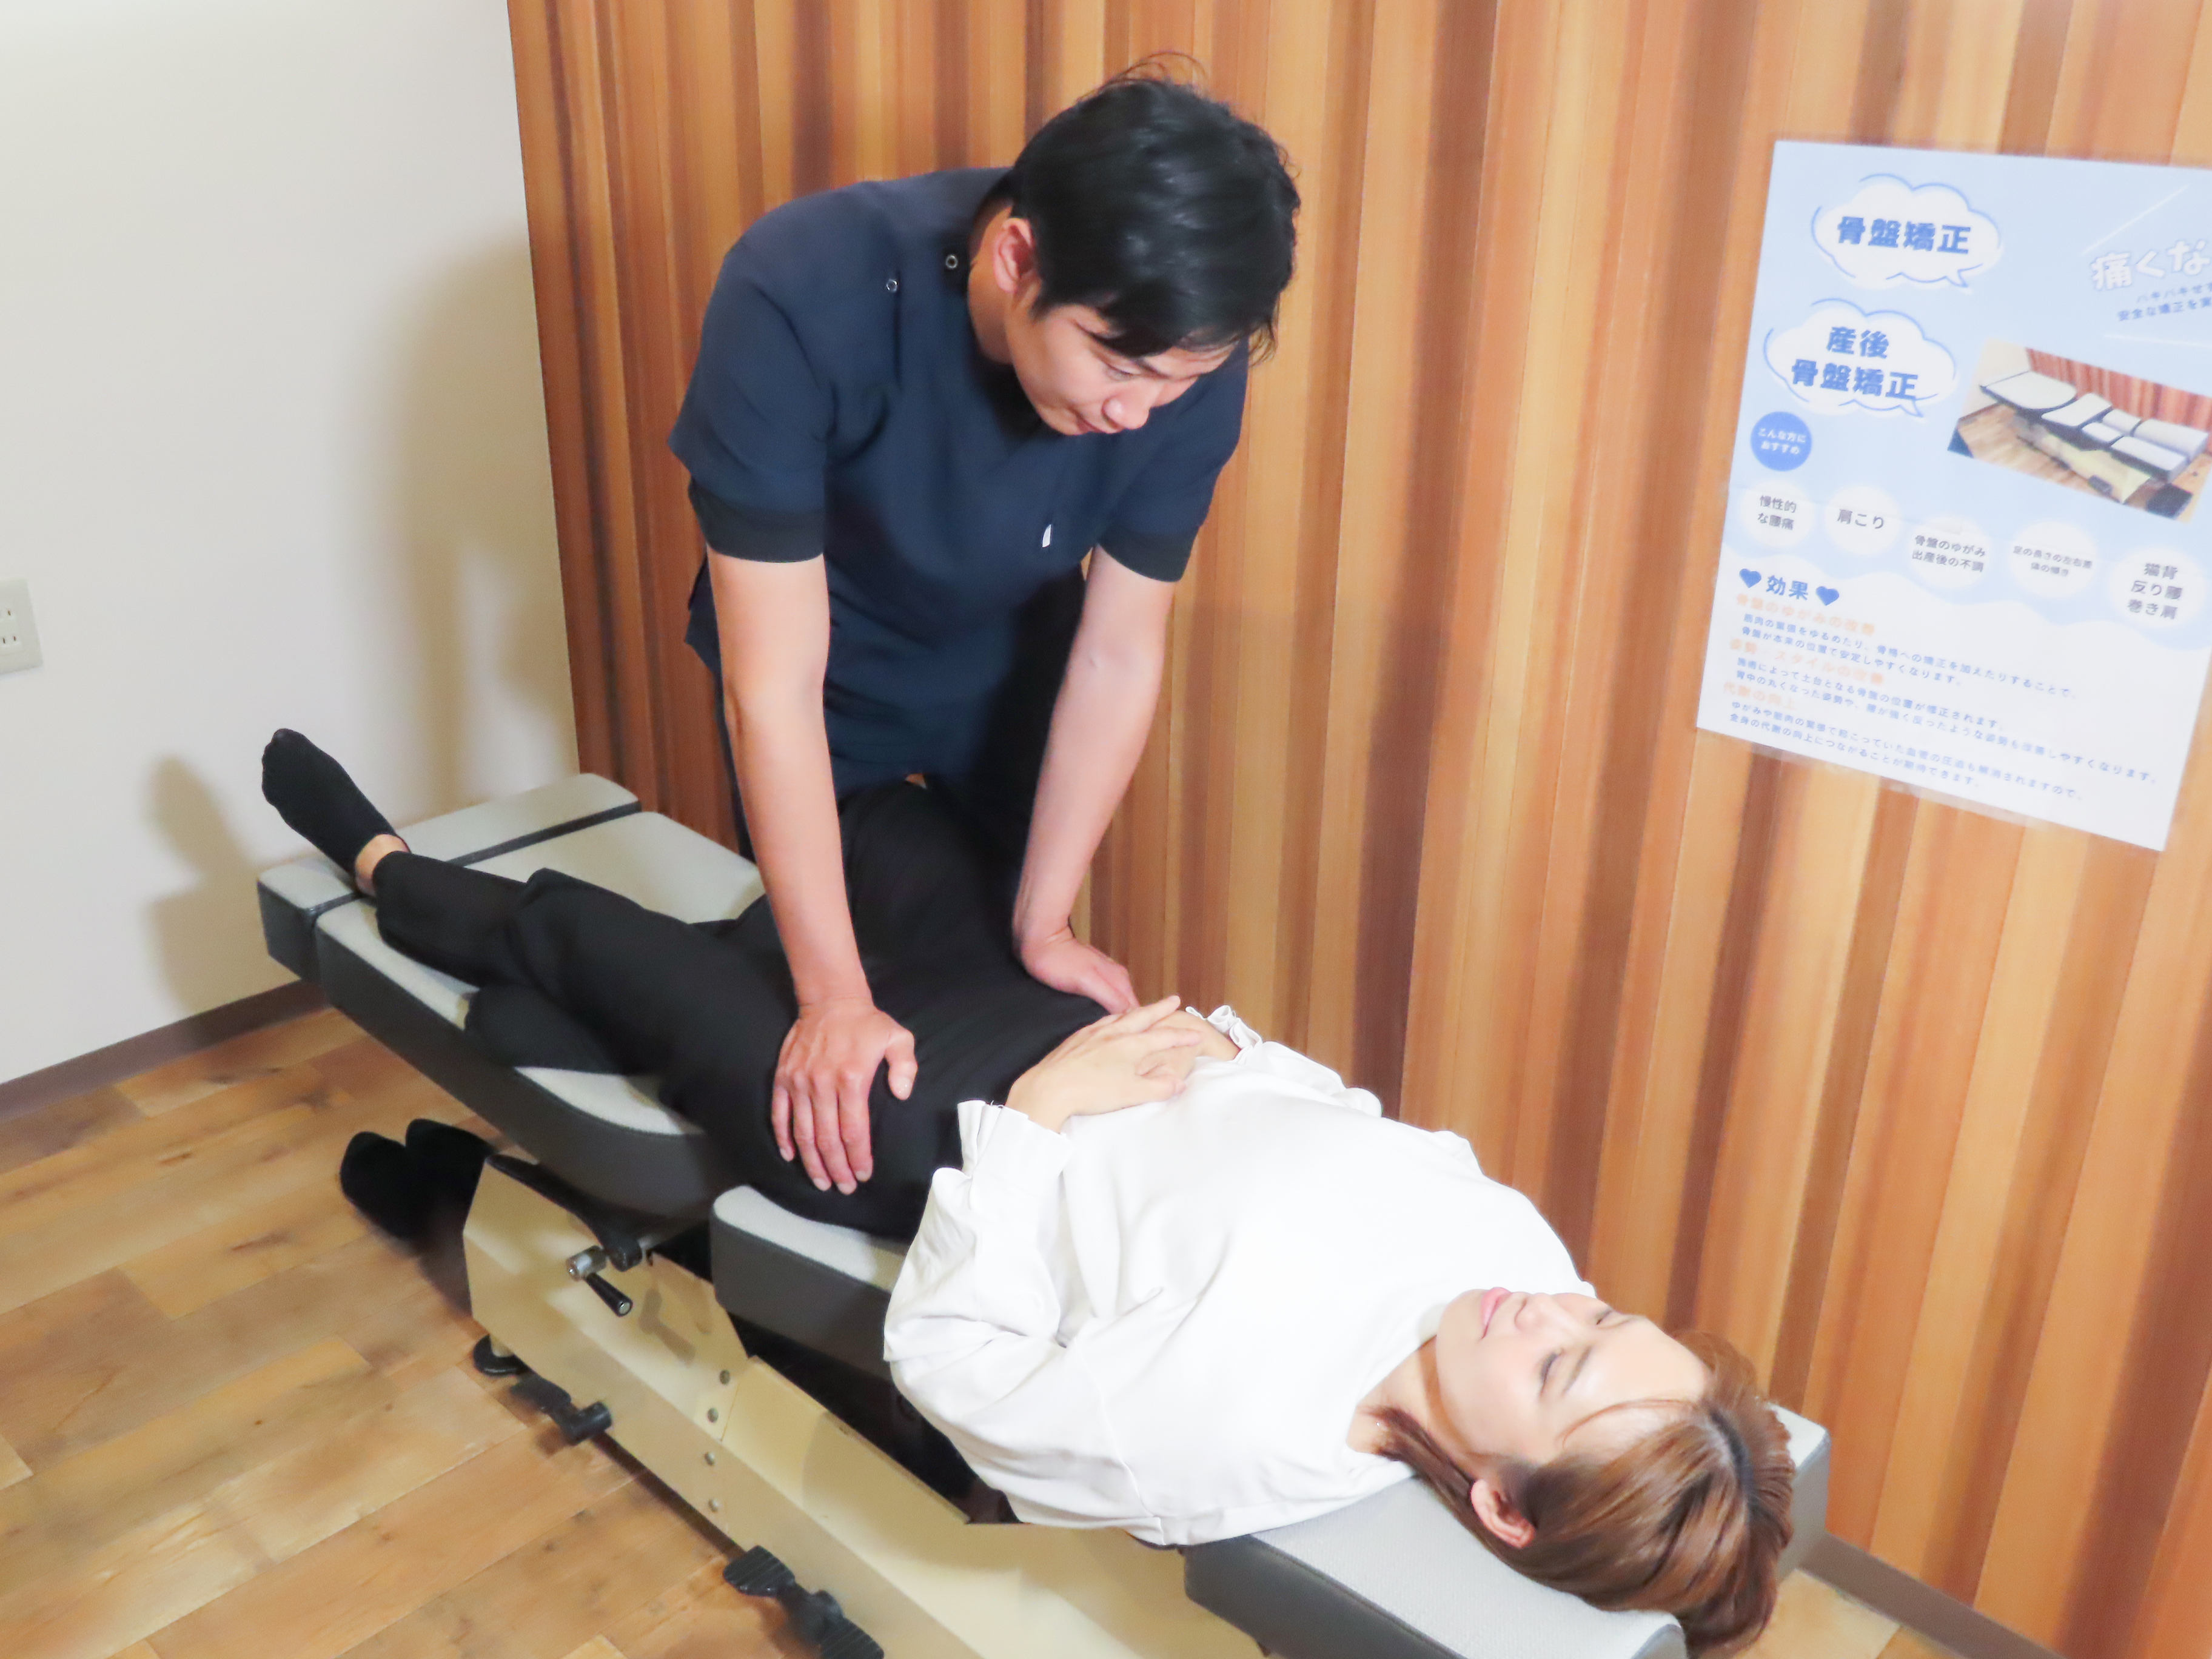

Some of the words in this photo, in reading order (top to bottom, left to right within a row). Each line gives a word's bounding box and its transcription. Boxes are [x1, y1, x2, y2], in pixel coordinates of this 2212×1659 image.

[1837, 216, 1971, 255] 骨盤矯正
[2090, 239, 2211, 291] 痛くな
[1826, 326, 1889, 359] 産後
[1791, 358, 1919, 401] 骨盤矯正
[1758, 427, 1807, 444] こんな方に
[1760, 441, 1800, 455] おすすめ
[1759, 495, 1797, 514] 慢性的
[1757, 512, 1795, 531] な腰痛
[1837, 508, 1885, 530] 肩こり
[1914, 534, 1986, 557] 骨盤のゆがみ
[1911, 549, 1985, 573] 出産後の不調
[2143, 563, 2179, 581] 猫背
[1765, 575, 1809, 601] 効果
[2130, 580, 2184, 600] 反り腰
[2127, 598, 2179, 620] 巻き肩
